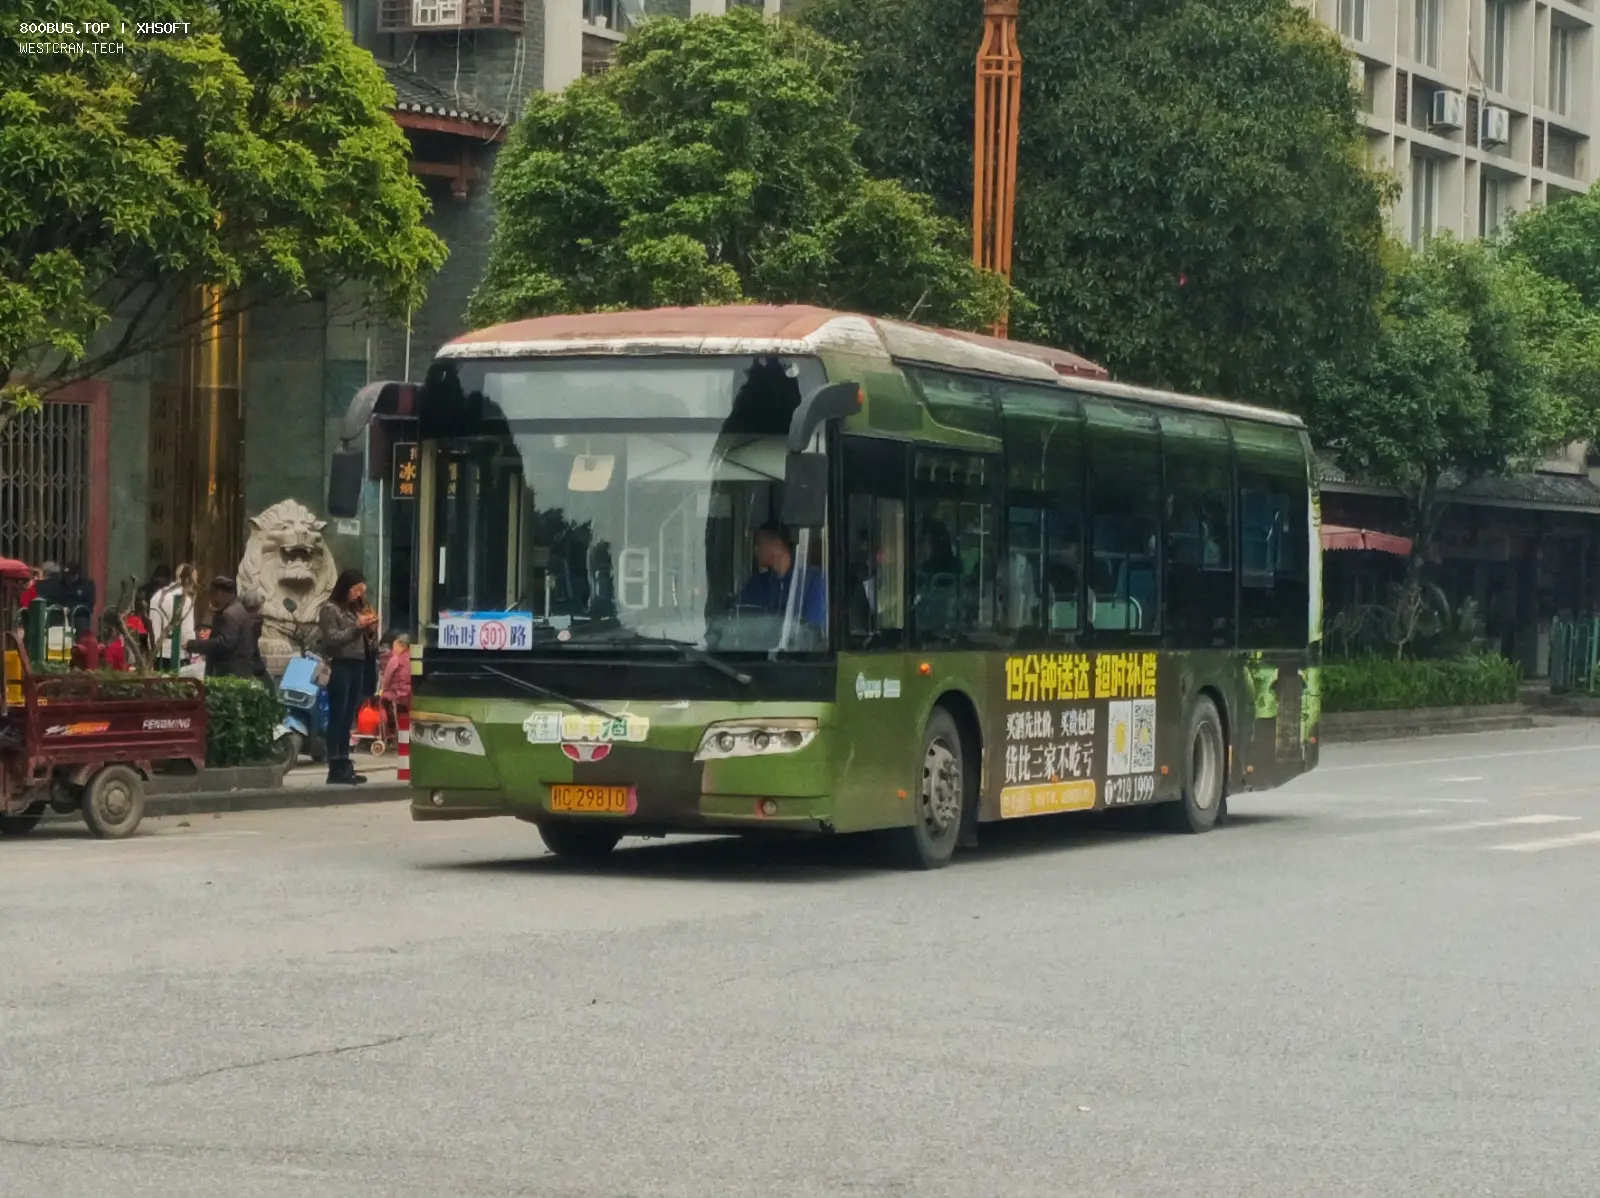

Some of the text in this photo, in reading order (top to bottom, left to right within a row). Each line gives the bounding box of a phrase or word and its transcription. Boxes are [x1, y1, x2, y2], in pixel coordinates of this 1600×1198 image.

[1005, 652, 1157, 701] 19分钟送达 超时补偿
[1005, 741, 1094, 784] 货比三家不吃亏
[1133, 775, 1155, 802] 1999
